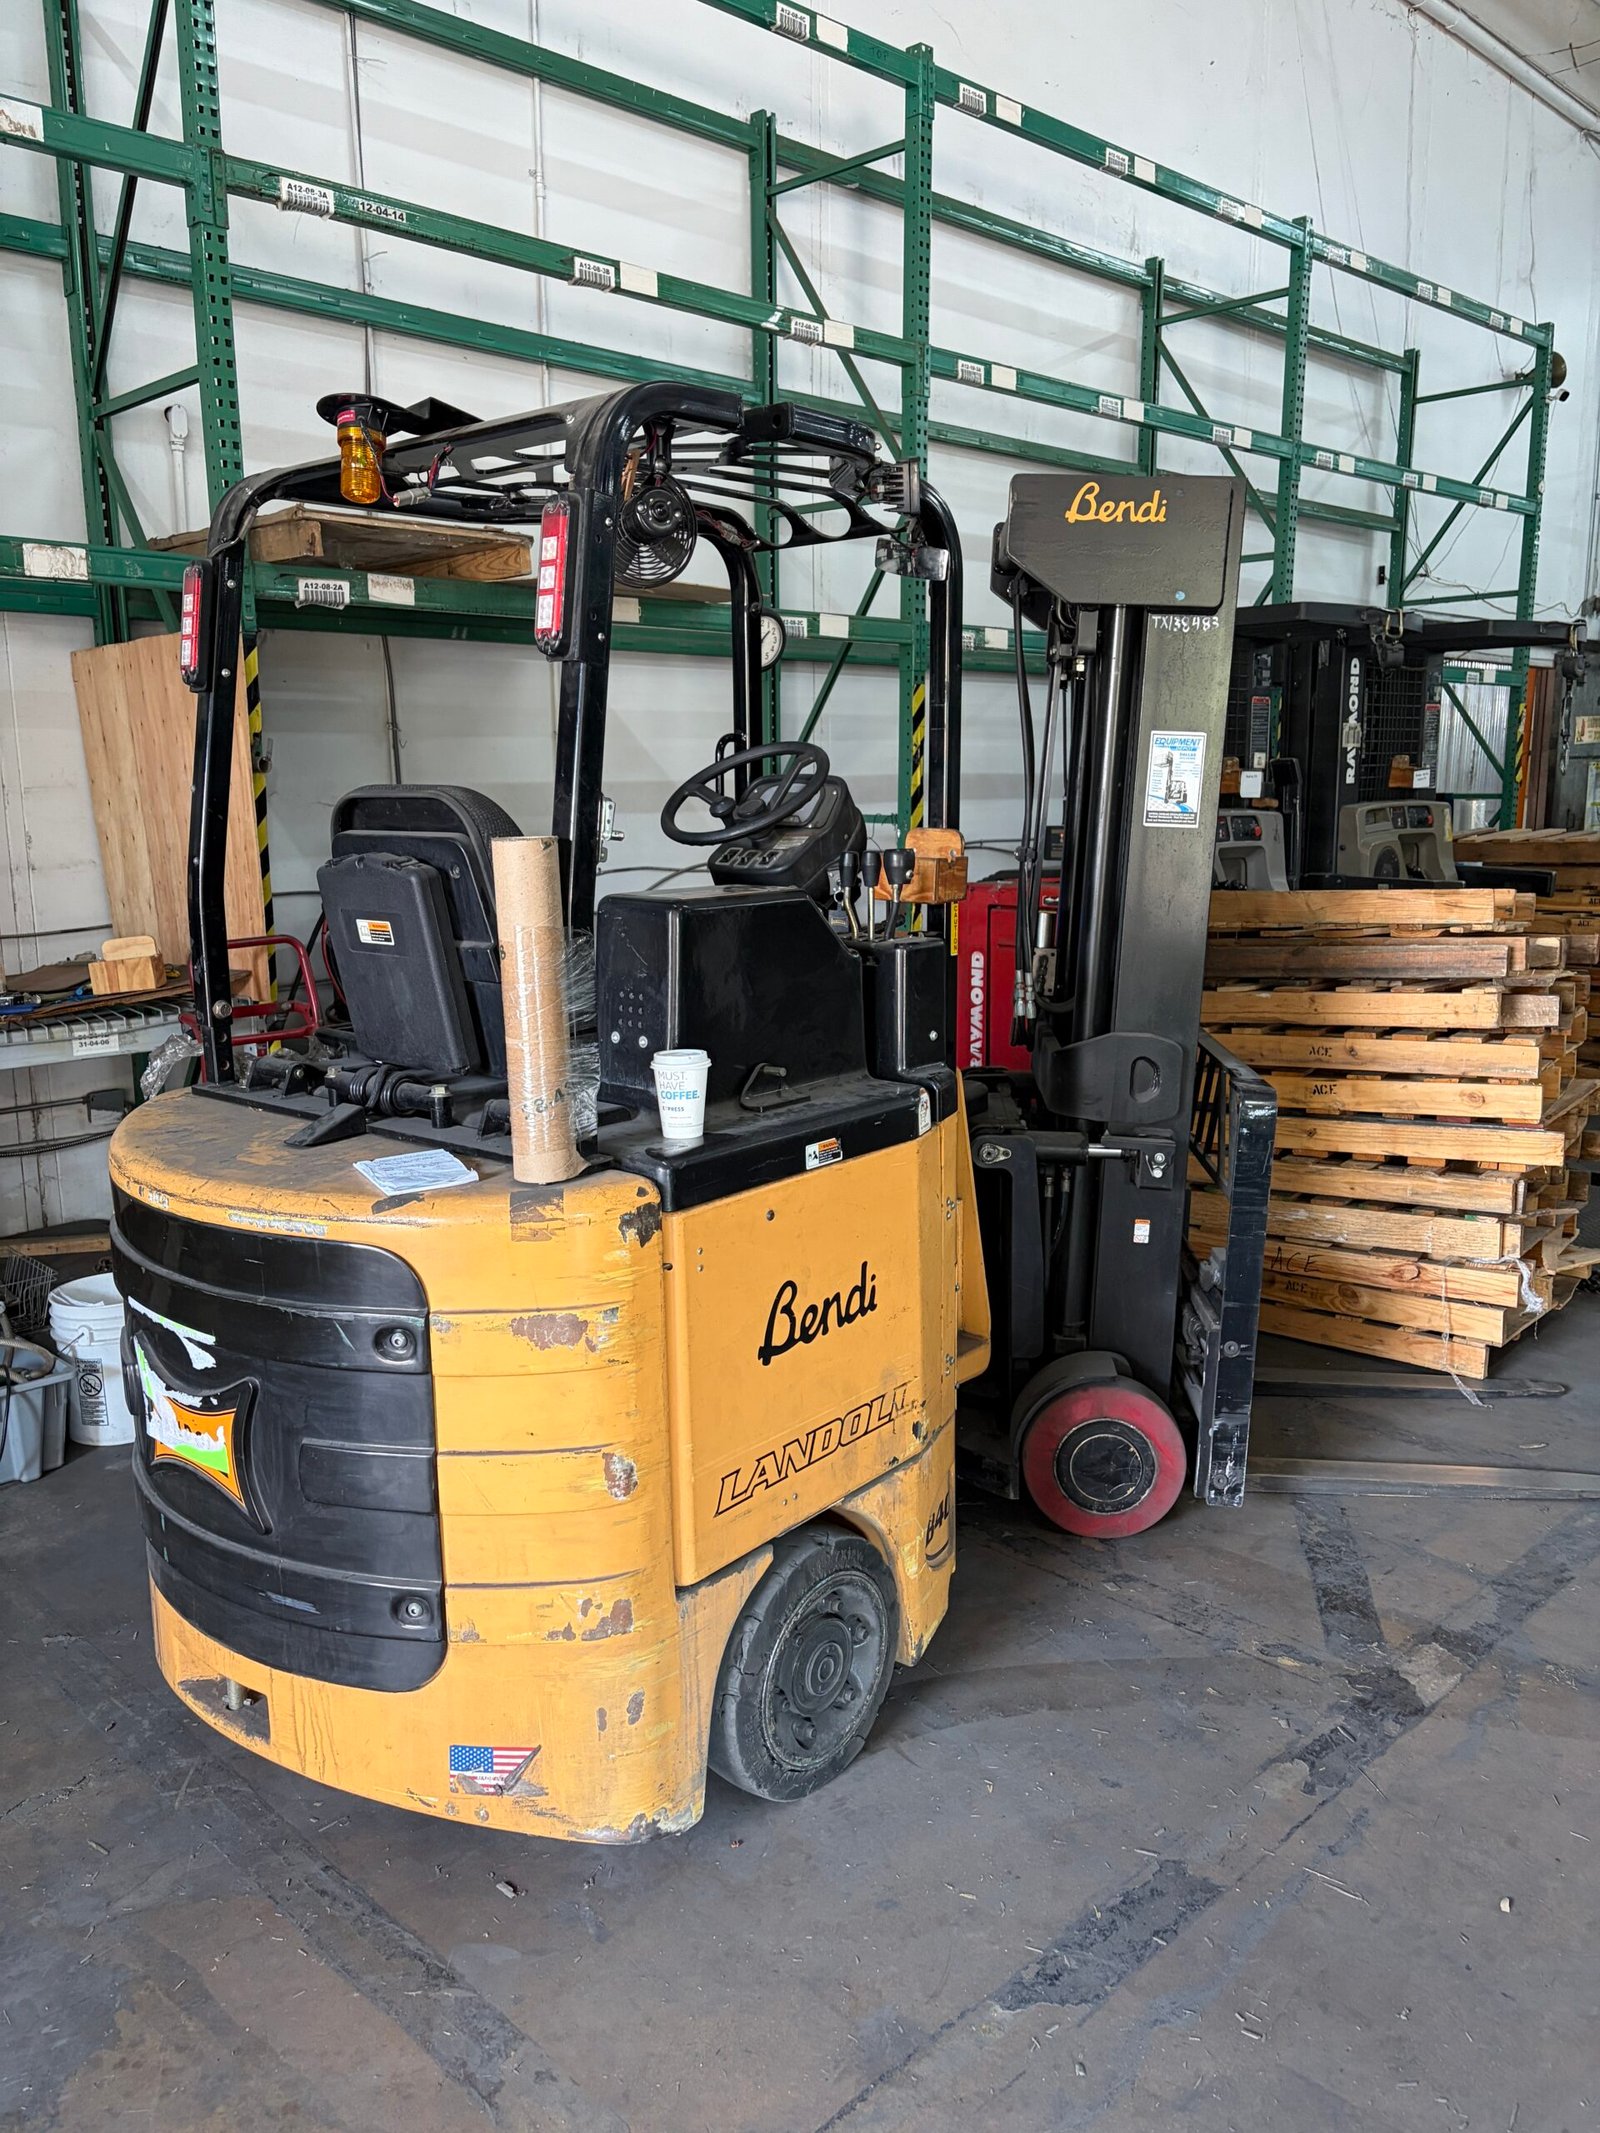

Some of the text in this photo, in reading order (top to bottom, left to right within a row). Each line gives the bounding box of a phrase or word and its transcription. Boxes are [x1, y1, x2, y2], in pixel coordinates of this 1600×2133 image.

[287, 182, 328, 200] A12-08-3A
[360, 200, 405, 222] 12-04-14
[579, 261, 611, 275] A12-08-3B
[1064, 481, 1168, 524] Bendi
[304, 582, 344, 591] A12-08-2A
[1154, 737, 1203, 747] EQUIPMENT
[1308, 1045, 1333, 1058] ACE
[658, 1071, 688, 1081] MUST.
[660, 1090, 700, 1100] COFFEE.
[1312, 1084, 1337, 1095] ACE
[1270, 1246, 1325, 1273] ACE
[757, 1260, 878, 1367] Bendi
